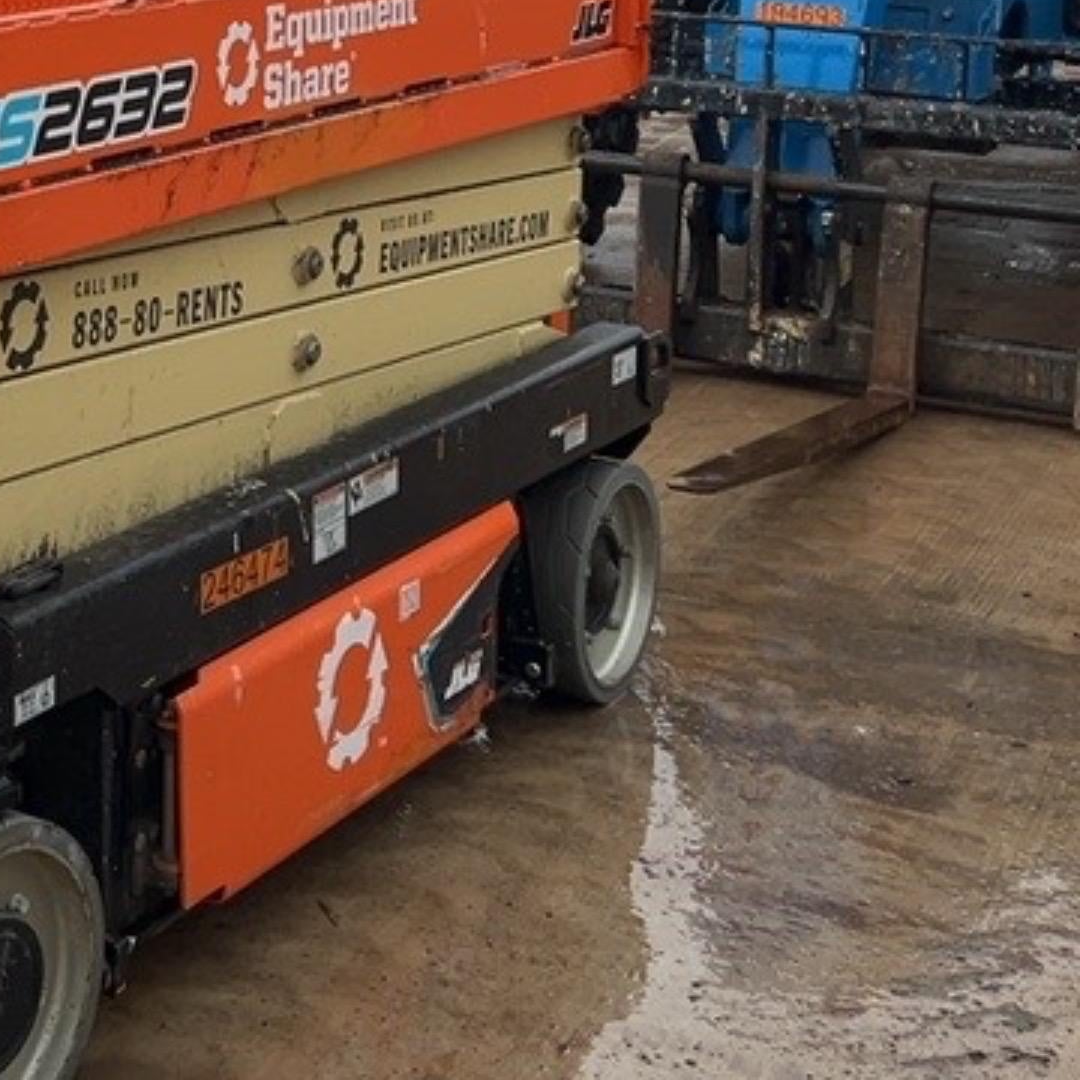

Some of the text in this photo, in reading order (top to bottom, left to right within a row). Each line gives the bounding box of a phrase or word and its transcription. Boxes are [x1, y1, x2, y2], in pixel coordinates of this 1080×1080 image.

[264, 59, 352, 110] Share
[380, 210, 551, 274] EQUIPMENTSHARE.COM
[72, 281, 244, 349] 888-80-RENTS
[74, 272, 139, 298] CALL NOW
[203, 540, 287, 610] 246474
